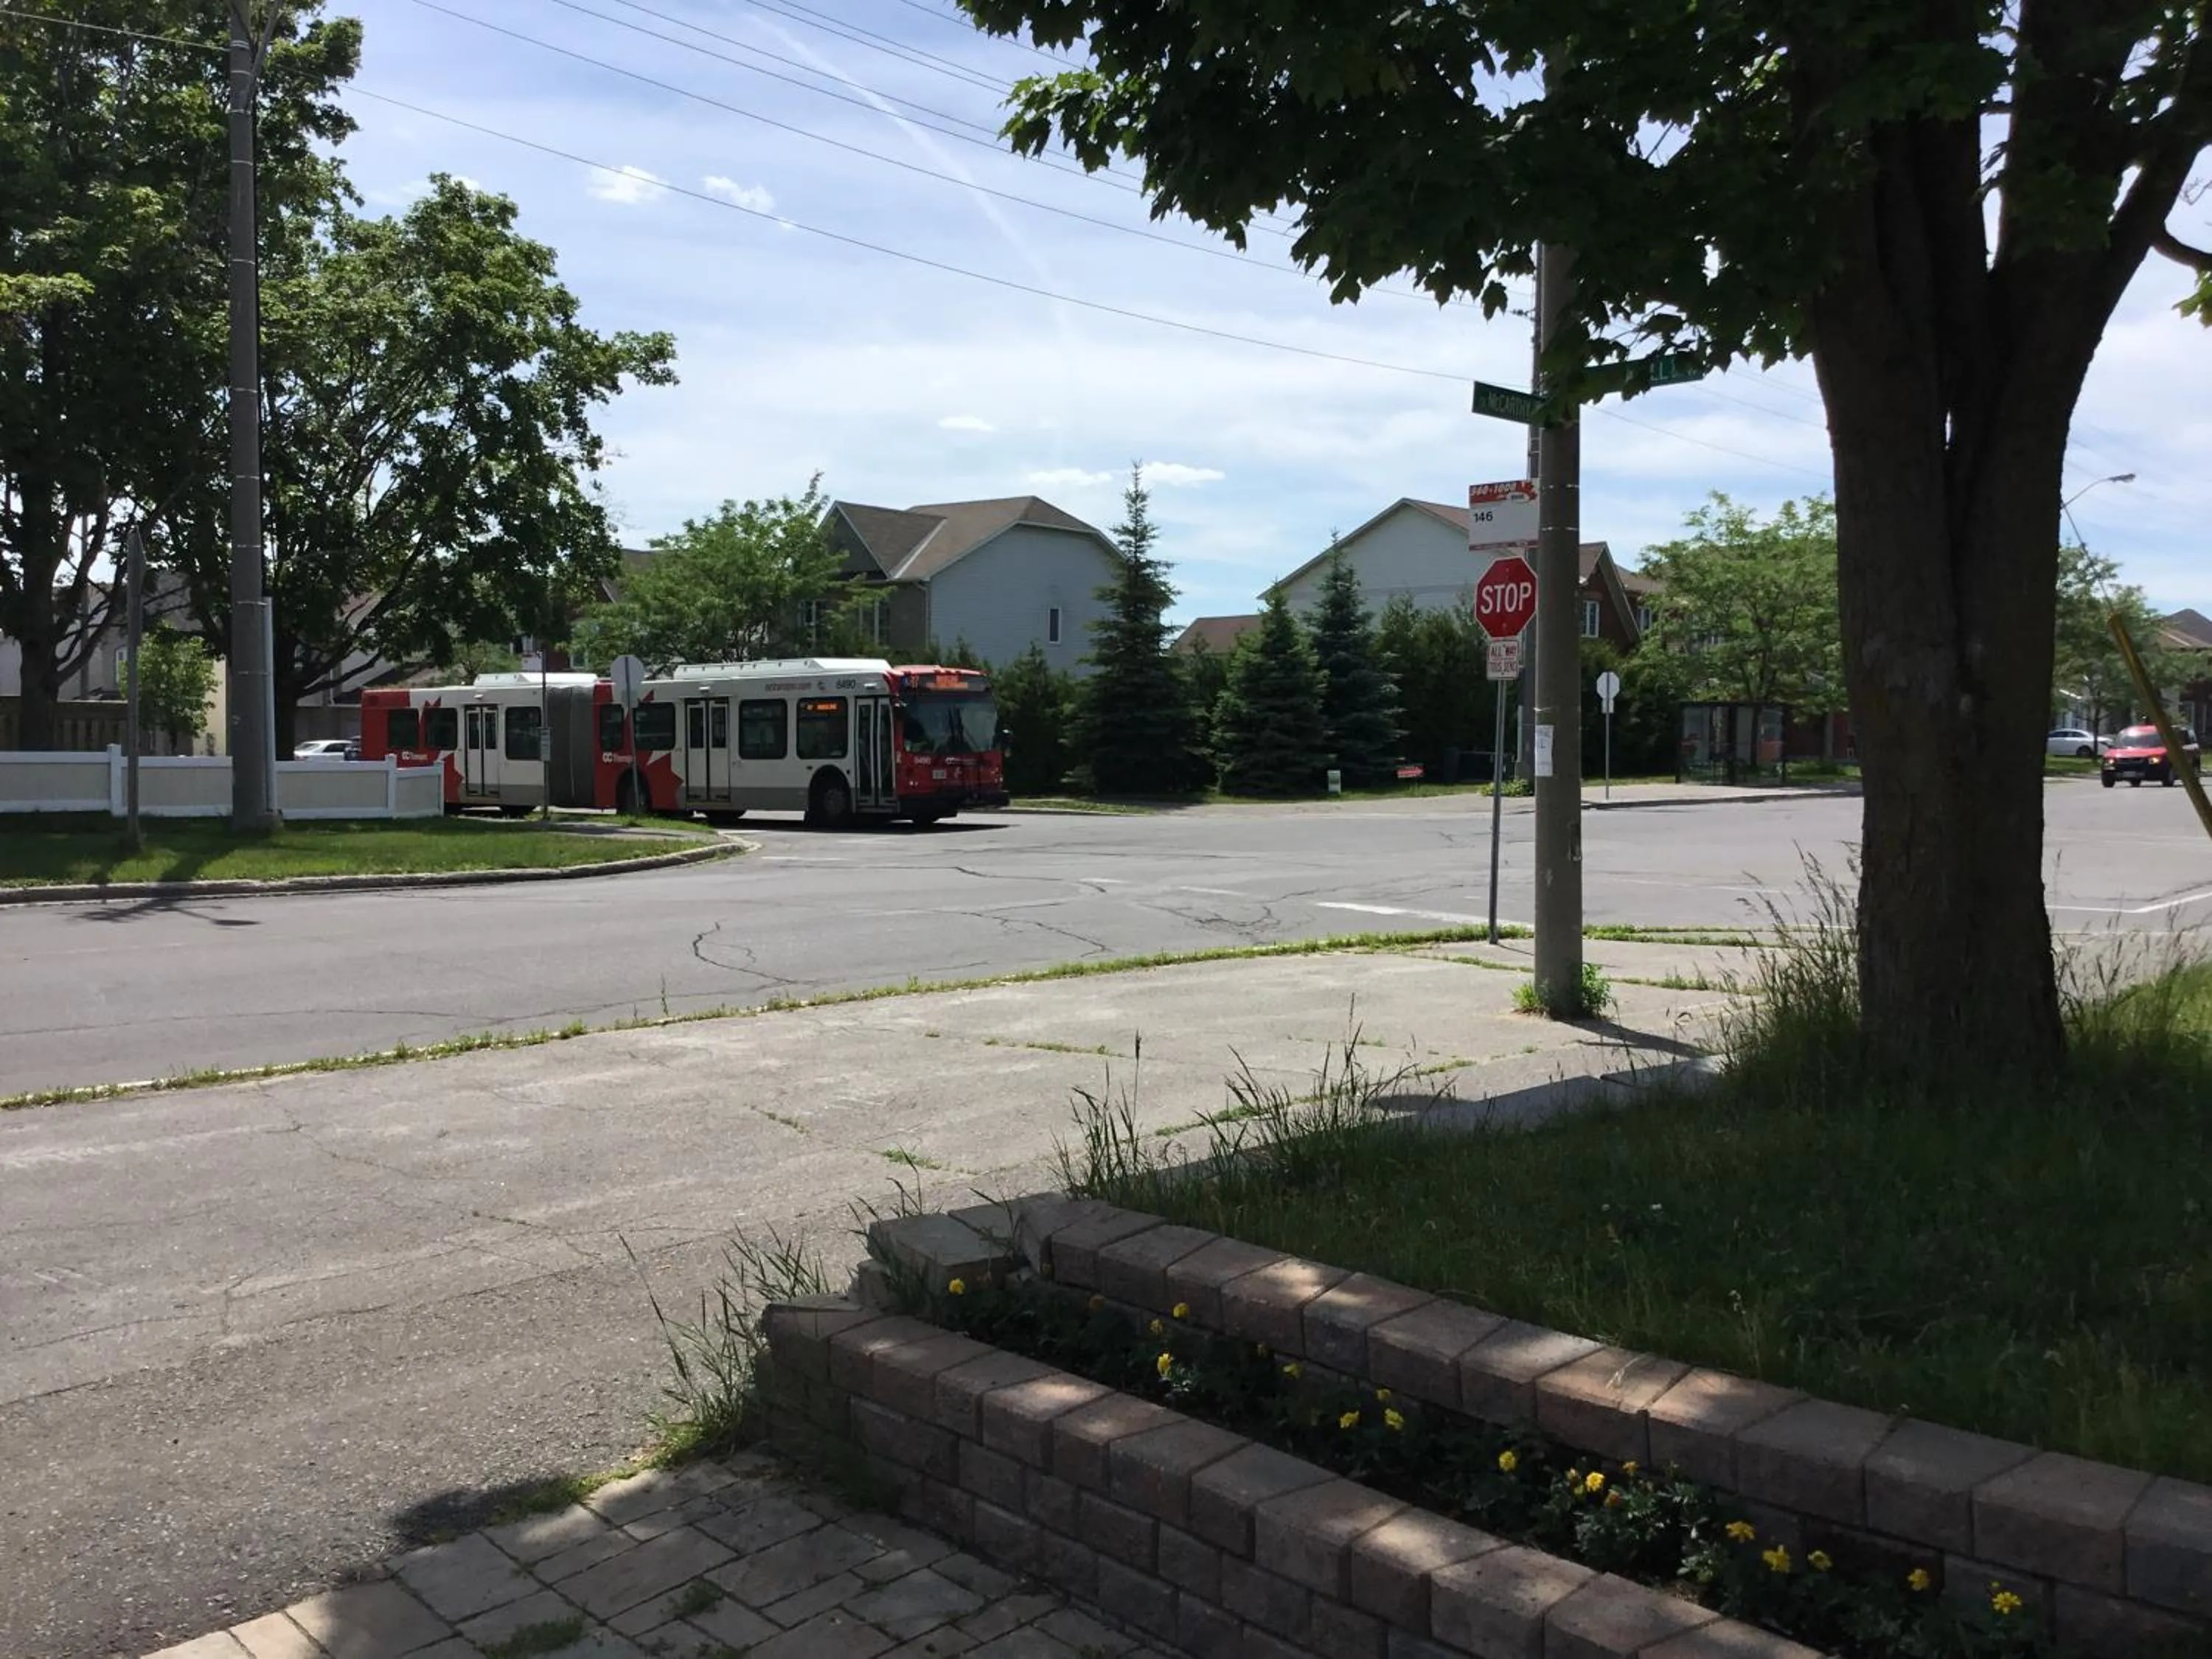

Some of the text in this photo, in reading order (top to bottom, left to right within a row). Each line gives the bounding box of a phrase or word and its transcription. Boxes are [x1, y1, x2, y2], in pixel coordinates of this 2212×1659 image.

[1474, 511, 1494, 523] 146
[1480, 581, 1532, 614] STOP
[1491, 646, 1503, 658] ALL
[836, 678, 856, 689] 6490
